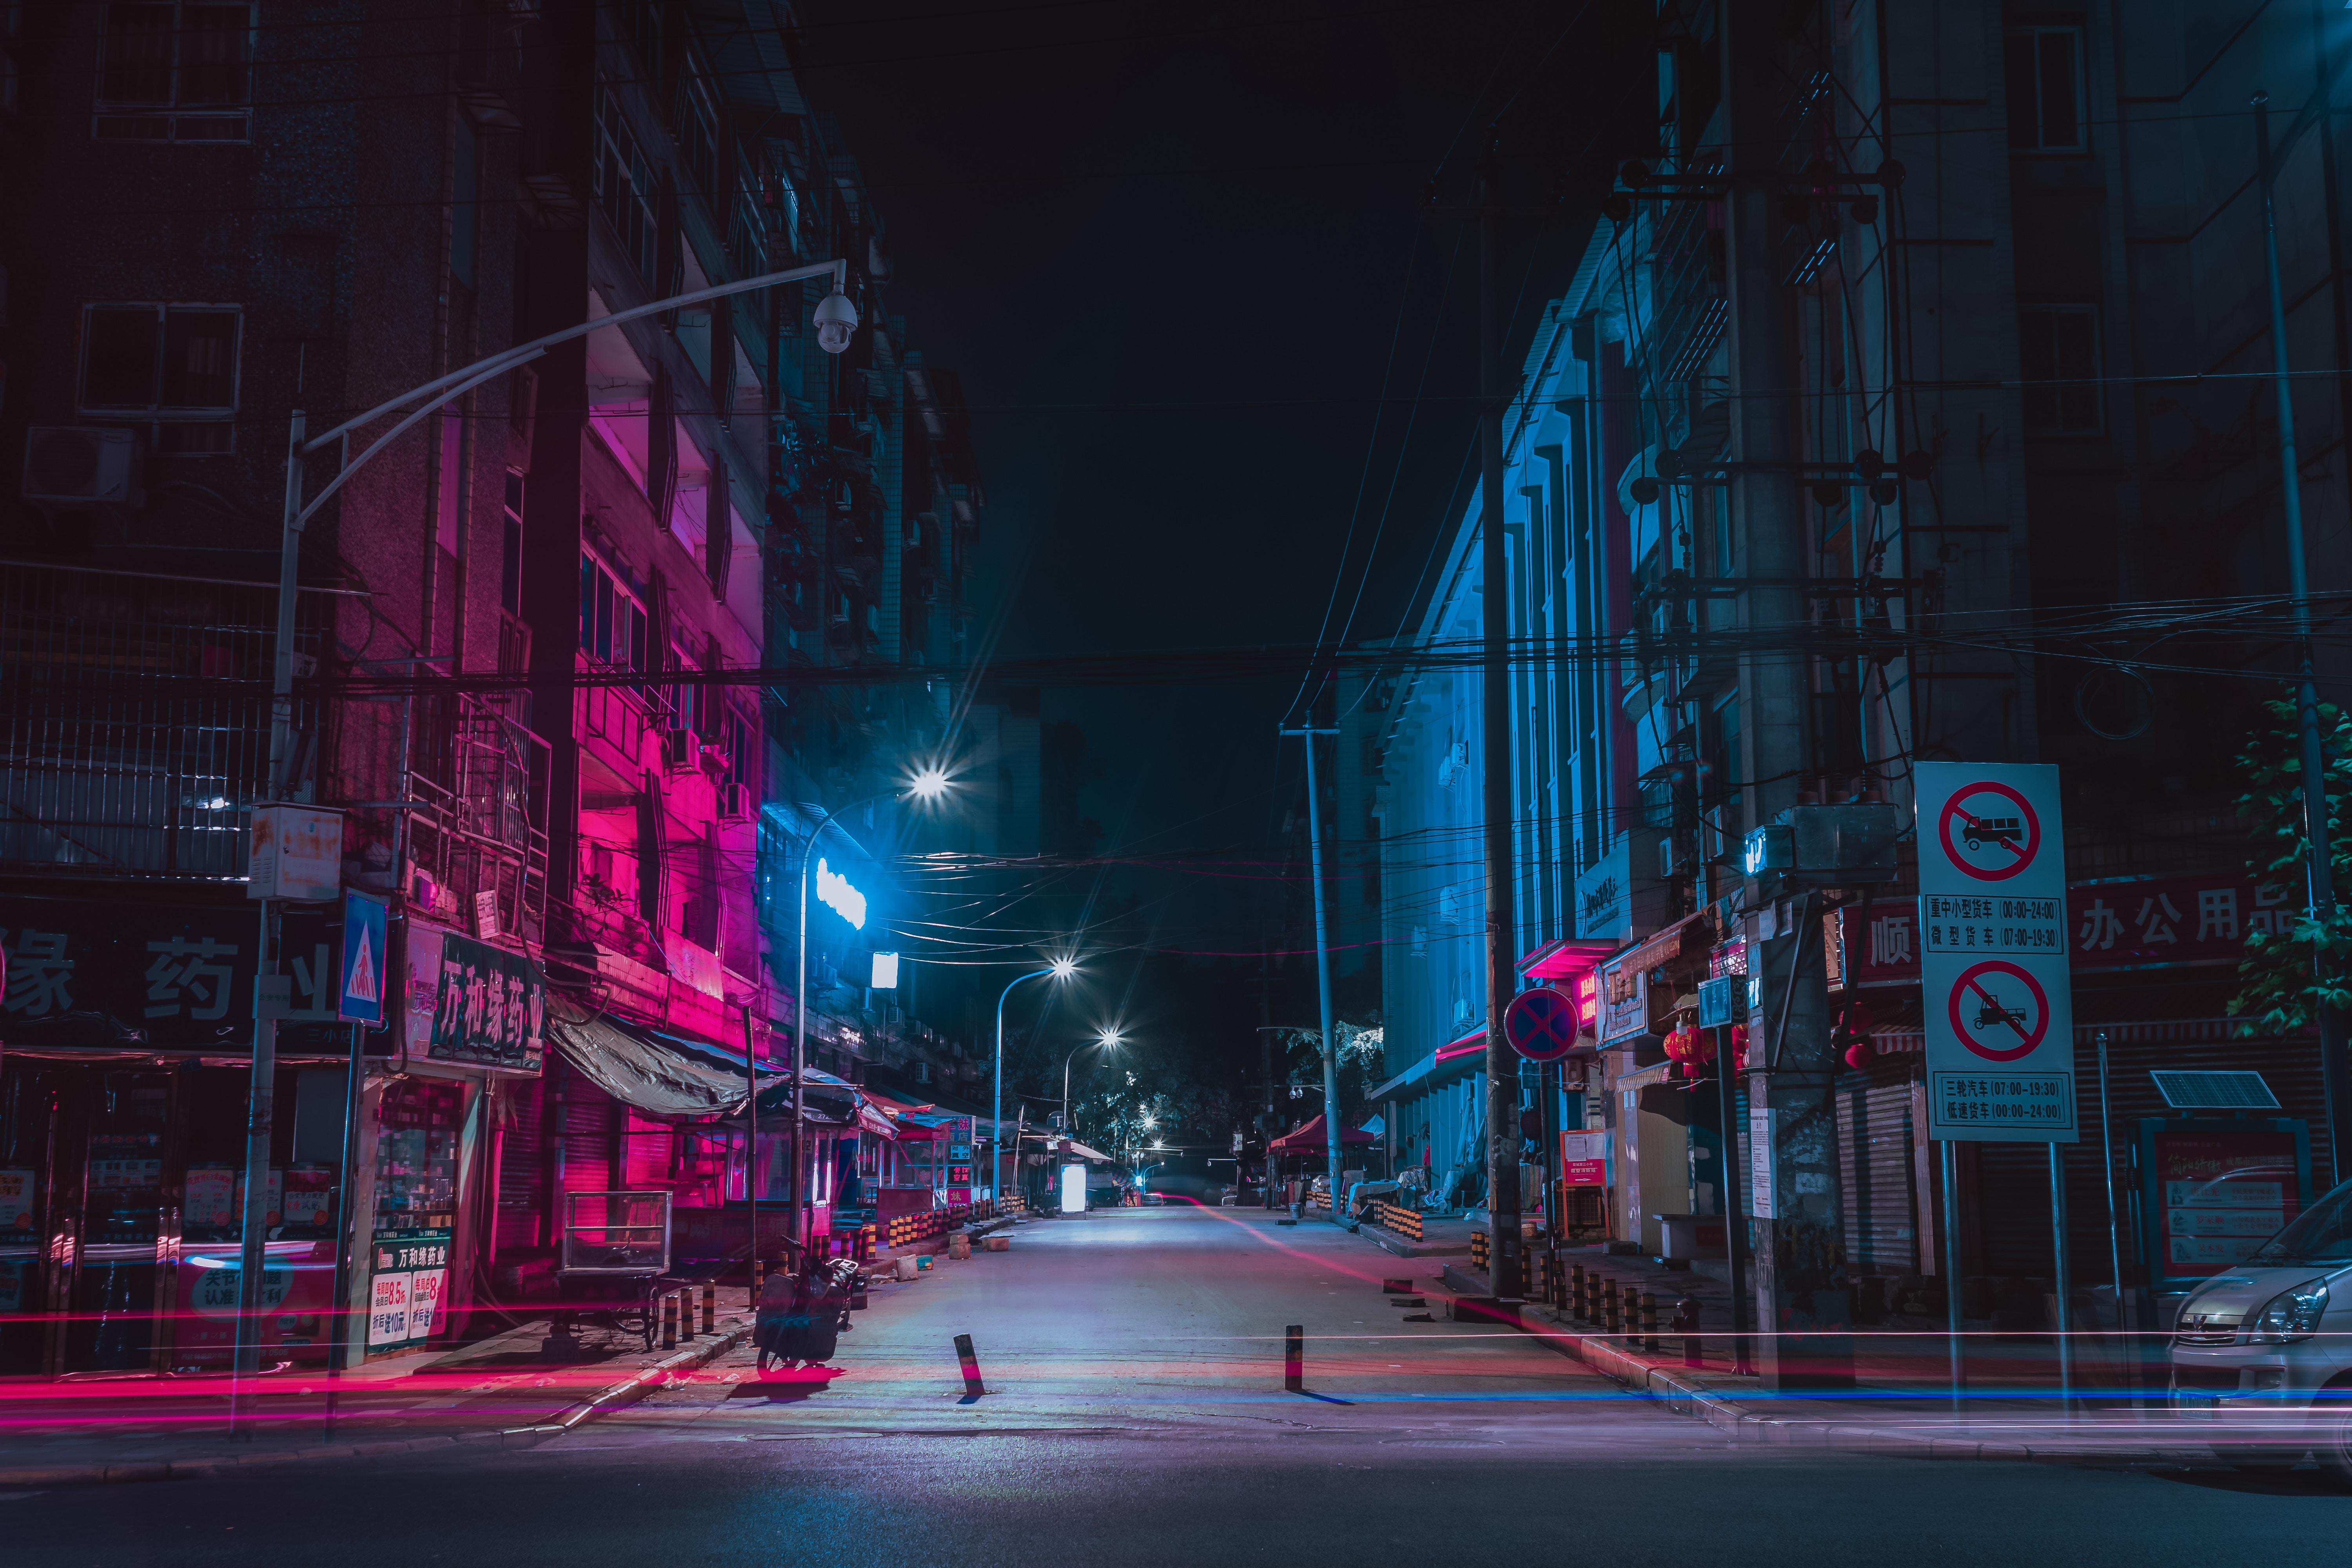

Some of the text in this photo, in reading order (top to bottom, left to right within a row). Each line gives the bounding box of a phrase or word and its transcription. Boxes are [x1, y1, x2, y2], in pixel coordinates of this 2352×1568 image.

[1930, 898, 2057, 920] 重中小型货车 (00:00-24:00)
[1871, 916, 1912, 967] 顺
[2080, 885, 2294, 952] 办公用品
[1931, 925, 2058, 947] 微型货车 (07:00-19:30)
[440, 959, 544, 1049] 万和缘药业
[1946, 1080, 2059, 1098] 三轮汽车 (07:00-19:30)
[1947, 1101, 2061, 1120] 低速货车 (00:00-24:00)
[399, 1246, 445, 1268] 万和缘药业
[205, 1287, 283, 1305] 认准利
[376, 1296, 388, 1307] 会员日
[373, 1311, 404, 1334] 折后送10元
